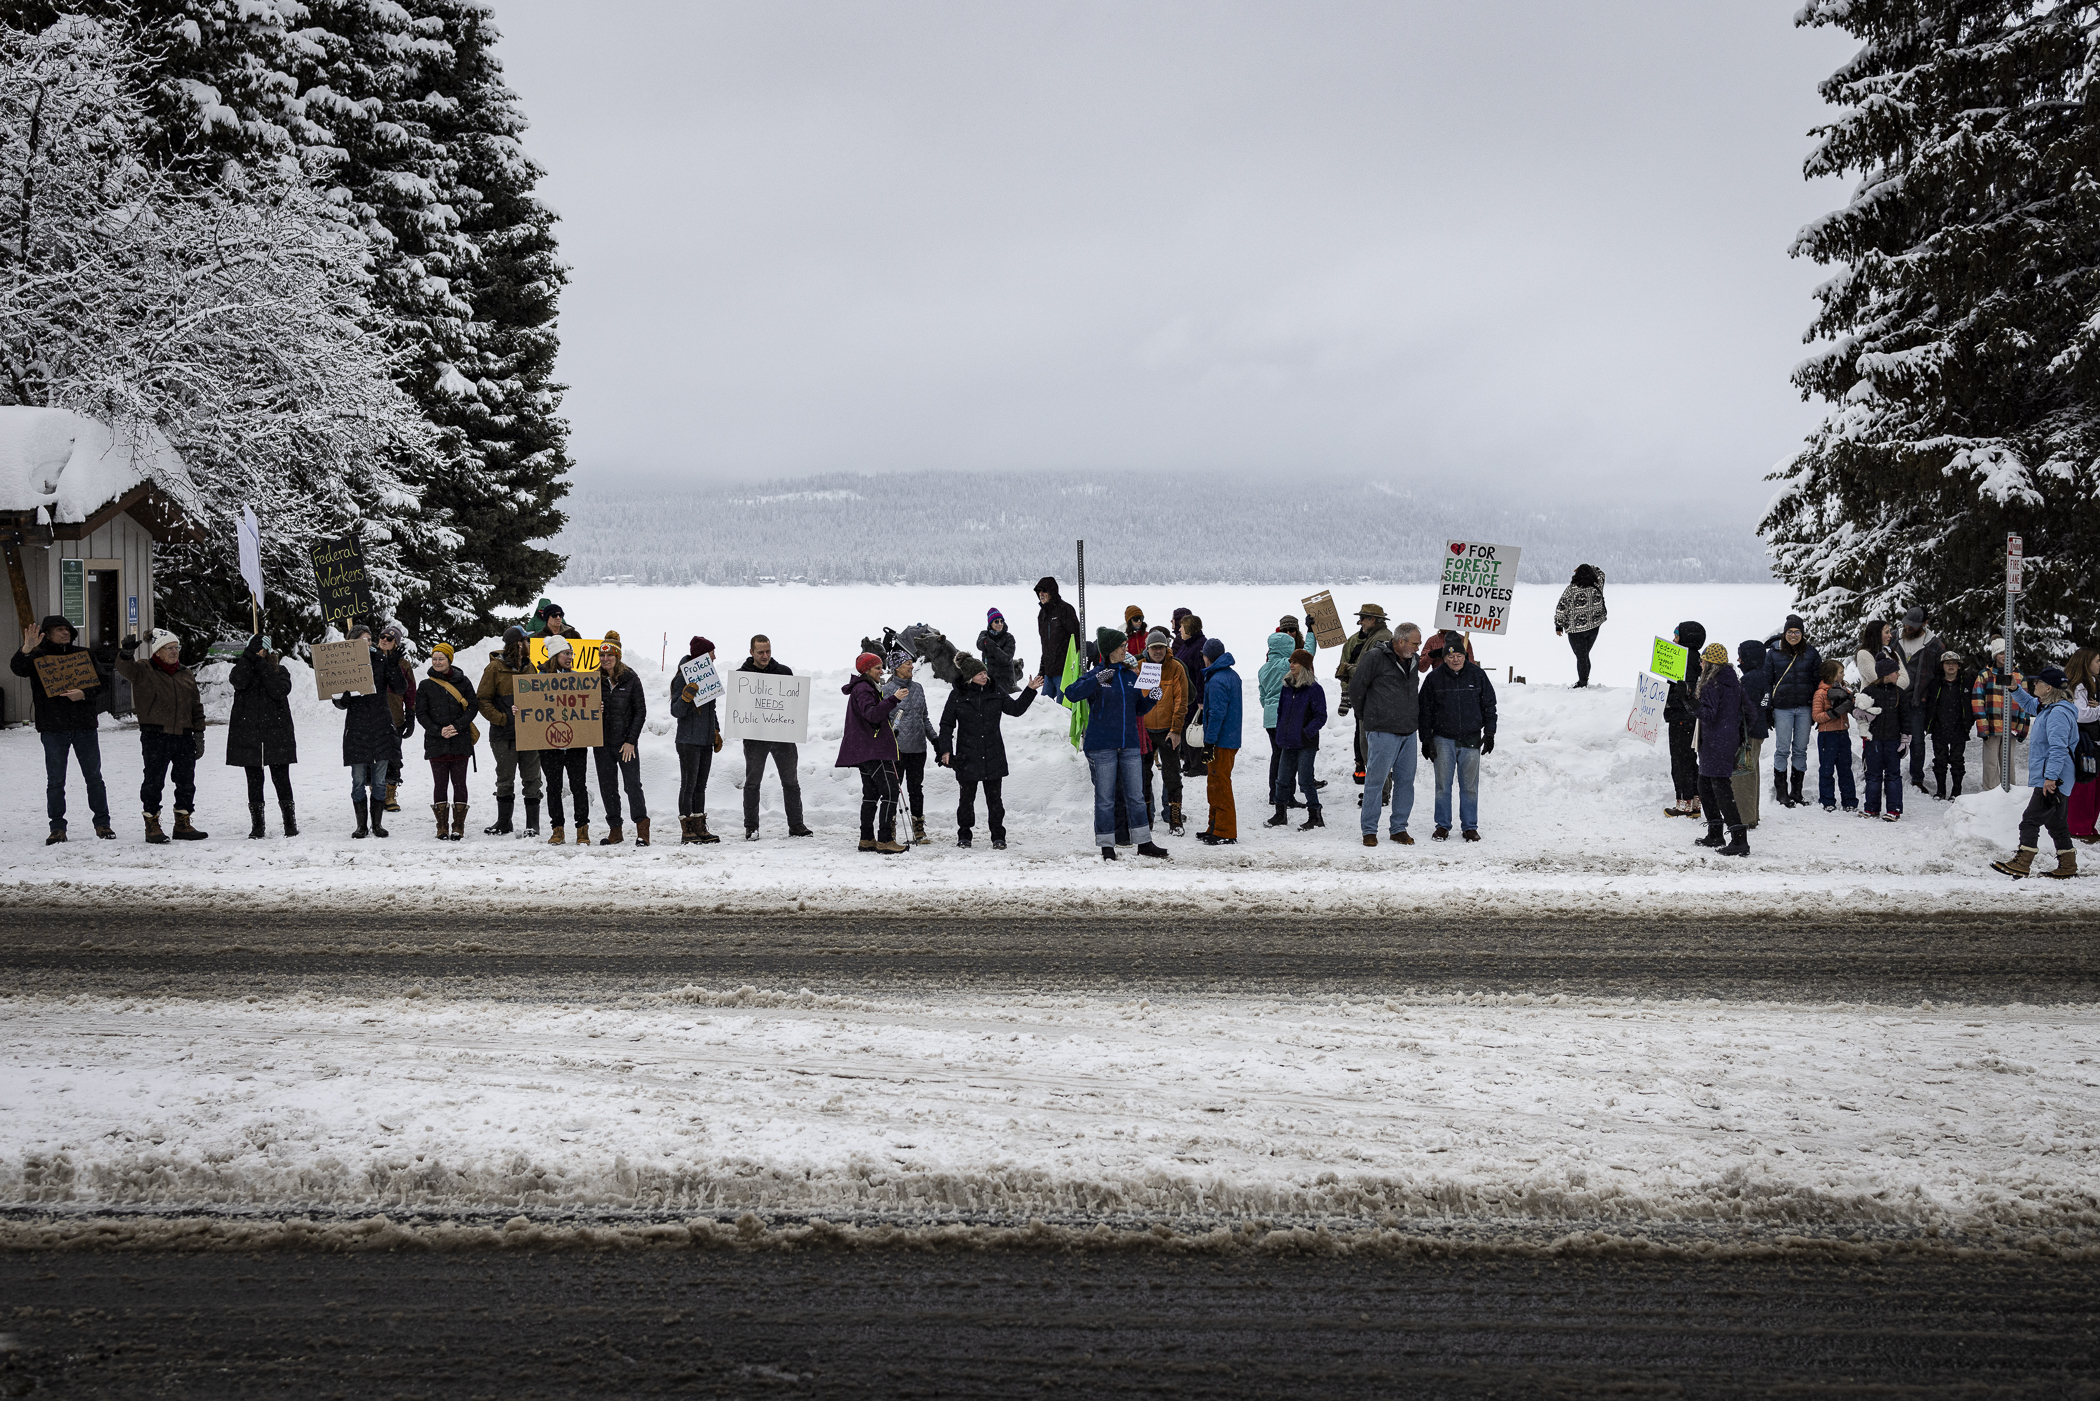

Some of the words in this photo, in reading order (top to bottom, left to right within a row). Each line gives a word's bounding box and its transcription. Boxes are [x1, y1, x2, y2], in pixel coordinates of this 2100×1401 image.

[313, 539, 358, 567] Federal
[1469, 545, 1496, 560] FOR
[1445, 558, 1502, 573] FOREST
[2010, 559, 2020, 570] FIRE
[315, 563, 364, 588] Workers
[1444, 569, 1499, 587] SERVICE
[2010, 573, 2020, 584] LANE
[332, 586, 351, 598] are
[1442, 584, 1512, 601] EMPLOYEES
[324, 593, 369, 622] Locals
[1308, 606, 1334, 619] SAVE
[1445, 601, 1480, 615] FIRED
[1488, 605, 1505, 618] BY
[1314, 618, 1341, 631] YOUR
[1454, 614, 1501, 631] TRUMP
[320, 641, 356, 651] DEPORT
[1655, 640, 1680, 656] Federal
[324, 658, 356, 666] AFRICAN
[1656, 649, 1673, 660] Workers
[37, 659, 57, 670] Federal
[325, 667, 363, 677] FASCIST
[683, 656, 711, 676] Protect
[42, 673, 65, 685] Protect
[74, 667, 90, 676] Rural
[518, 676, 600, 693] DEMOCRACY
[738, 676, 773, 695] Public
[779, 680, 800, 697] Land
[1639, 674, 1649, 698] We
[544, 693, 555, 702] is
[556, 694, 590, 708] NOT
[755, 698, 784, 709] NEEDS
[520, 707, 556, 723] FOR
[561, 706, 600, 722] $ALE
[733, 709, 758, 724] Public
[762, 713, 795, 725] Workers
[549, 729, 573, 744] MUSK
